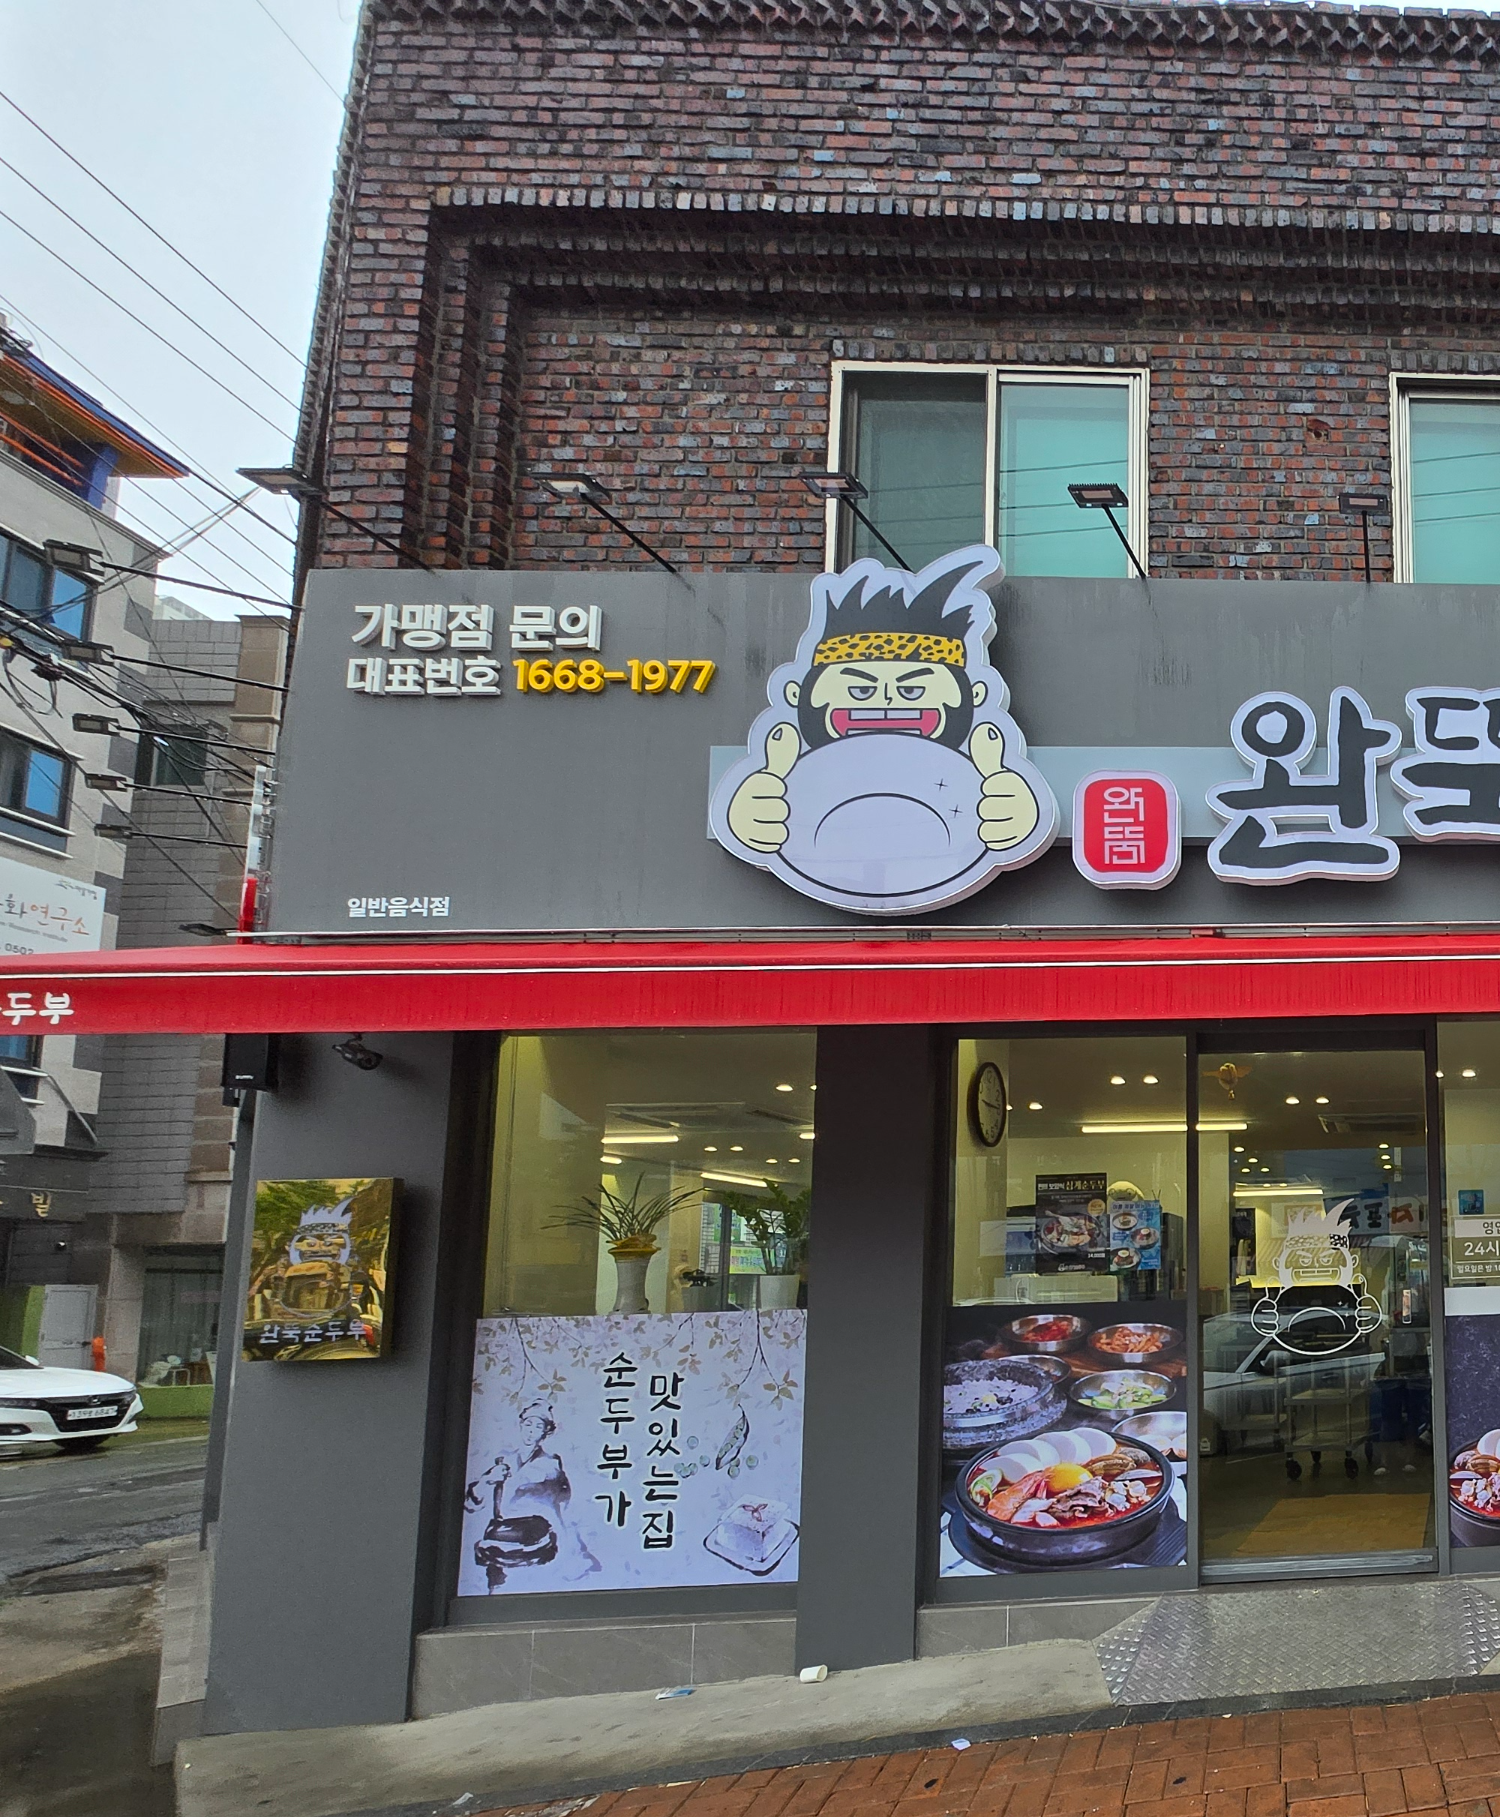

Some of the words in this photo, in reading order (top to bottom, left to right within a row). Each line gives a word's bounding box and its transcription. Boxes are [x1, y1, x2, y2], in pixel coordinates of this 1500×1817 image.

[352, 603, 494, 650] 가맹점
[509, 604, 603, 650] 문의
[346, 655, 501, 696] 대표번호
[512, 657, 716, 693] 1668-1977
[346, 896, 451, 918] 일반음식점
[258, 1320, 367, 1344] 완뚝순두부
[594, 1351, 639, 1528] 순두부가
